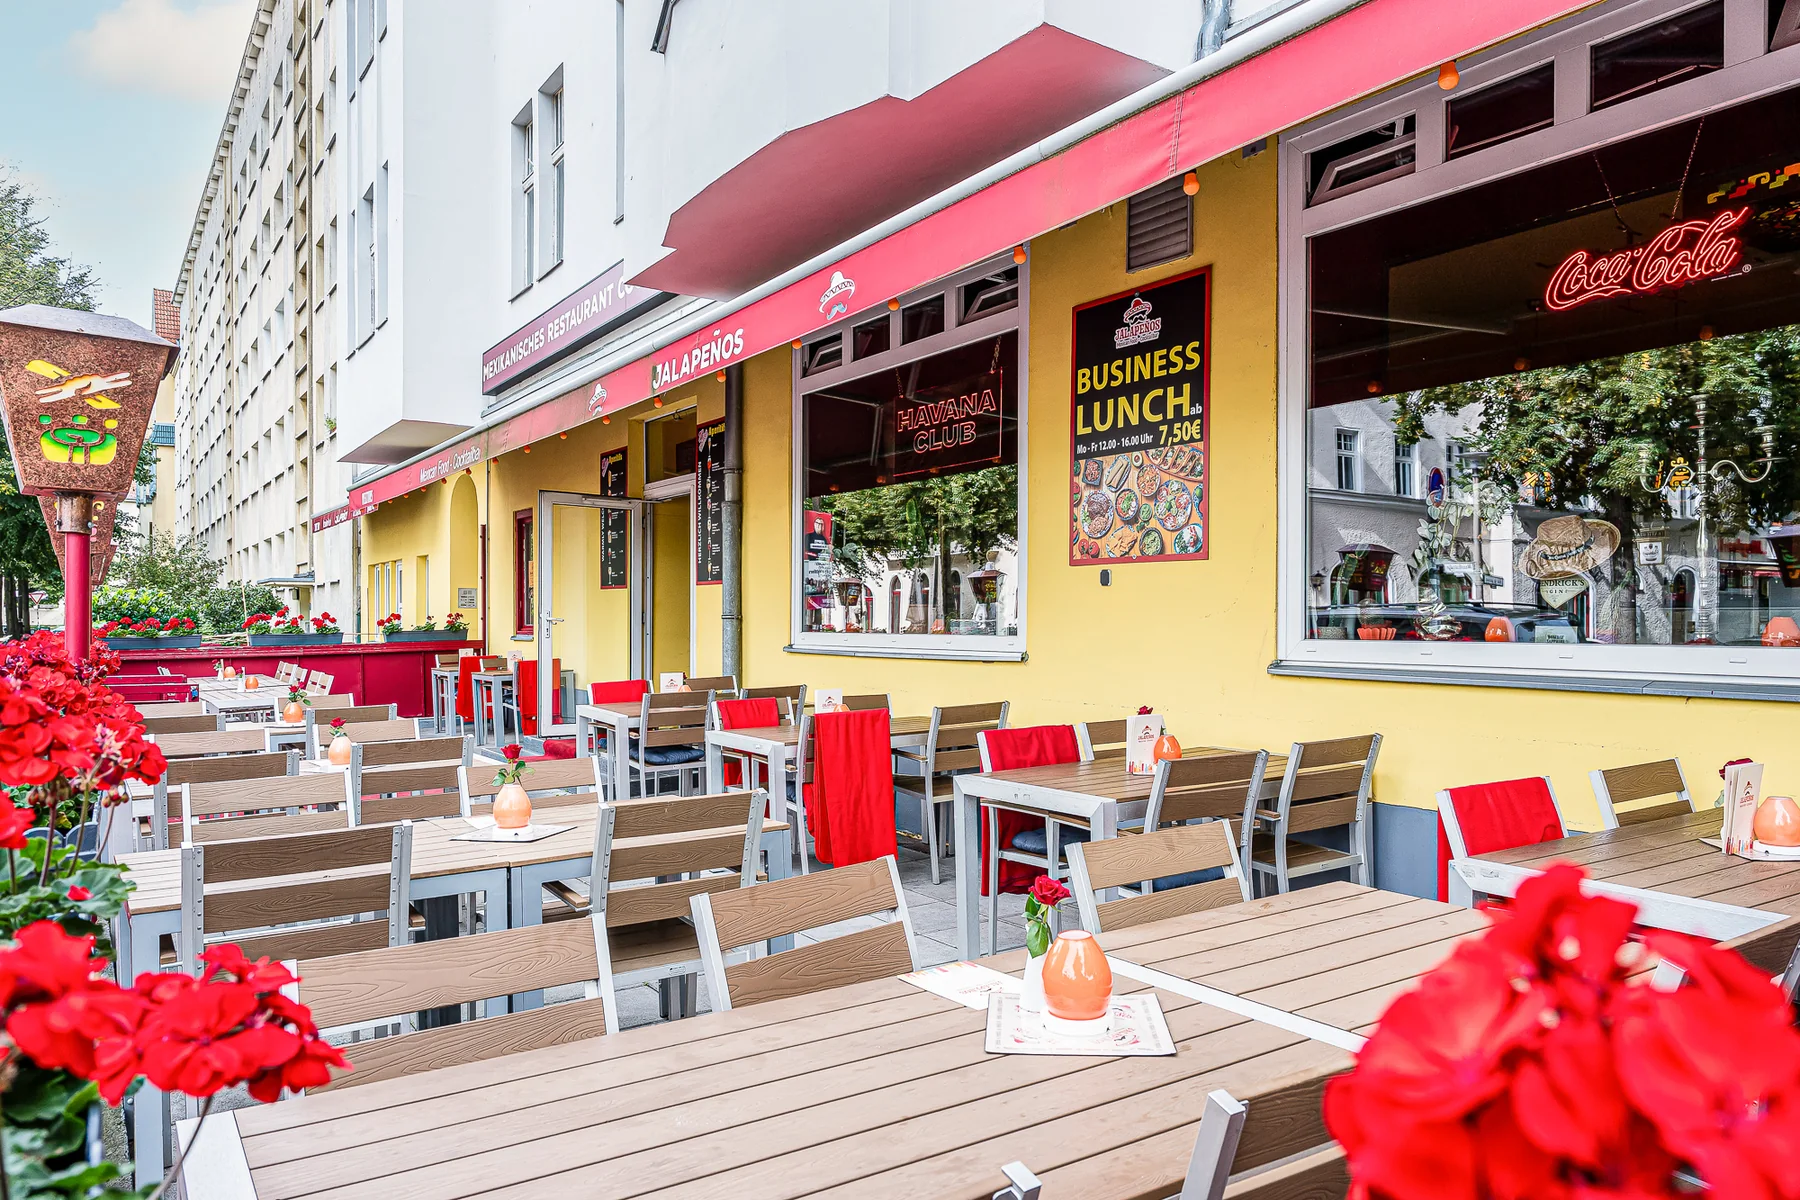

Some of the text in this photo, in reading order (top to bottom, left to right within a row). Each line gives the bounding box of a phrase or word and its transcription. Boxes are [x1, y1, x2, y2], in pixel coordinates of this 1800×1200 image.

[1545, 206, 1749, 310] Coca-Cola
[483, 327, 545, 382] MEXIKANISCHES
[547, 283, 615, 343] RESTAURANT
[1115, 319, 1161, 341] JALAPEÑOS
[652, 328, 744, 390] JALAPEÑOS
[1077, 341, 1201, 395] BUSINESS
[896, 389, 997, 432] HAVANA
[1076, 383, 1202, 436] LUNCH ab
[913, 421, 977, 454] CLUB
[1076, 445, 1087, 454] Mo
[1091, 442, 1098, 453] Fr
[1099, 439, 1116, 451] 12.00
[1121, 436, 1140, 448] 16.00
[1140, 433, 1154, 444] Uhr
[1159, 419, 1201, 447] 7,50€
[438, 457, 450, 476] Food
[1540, 579, 1585, 587] ENDRICK'S
